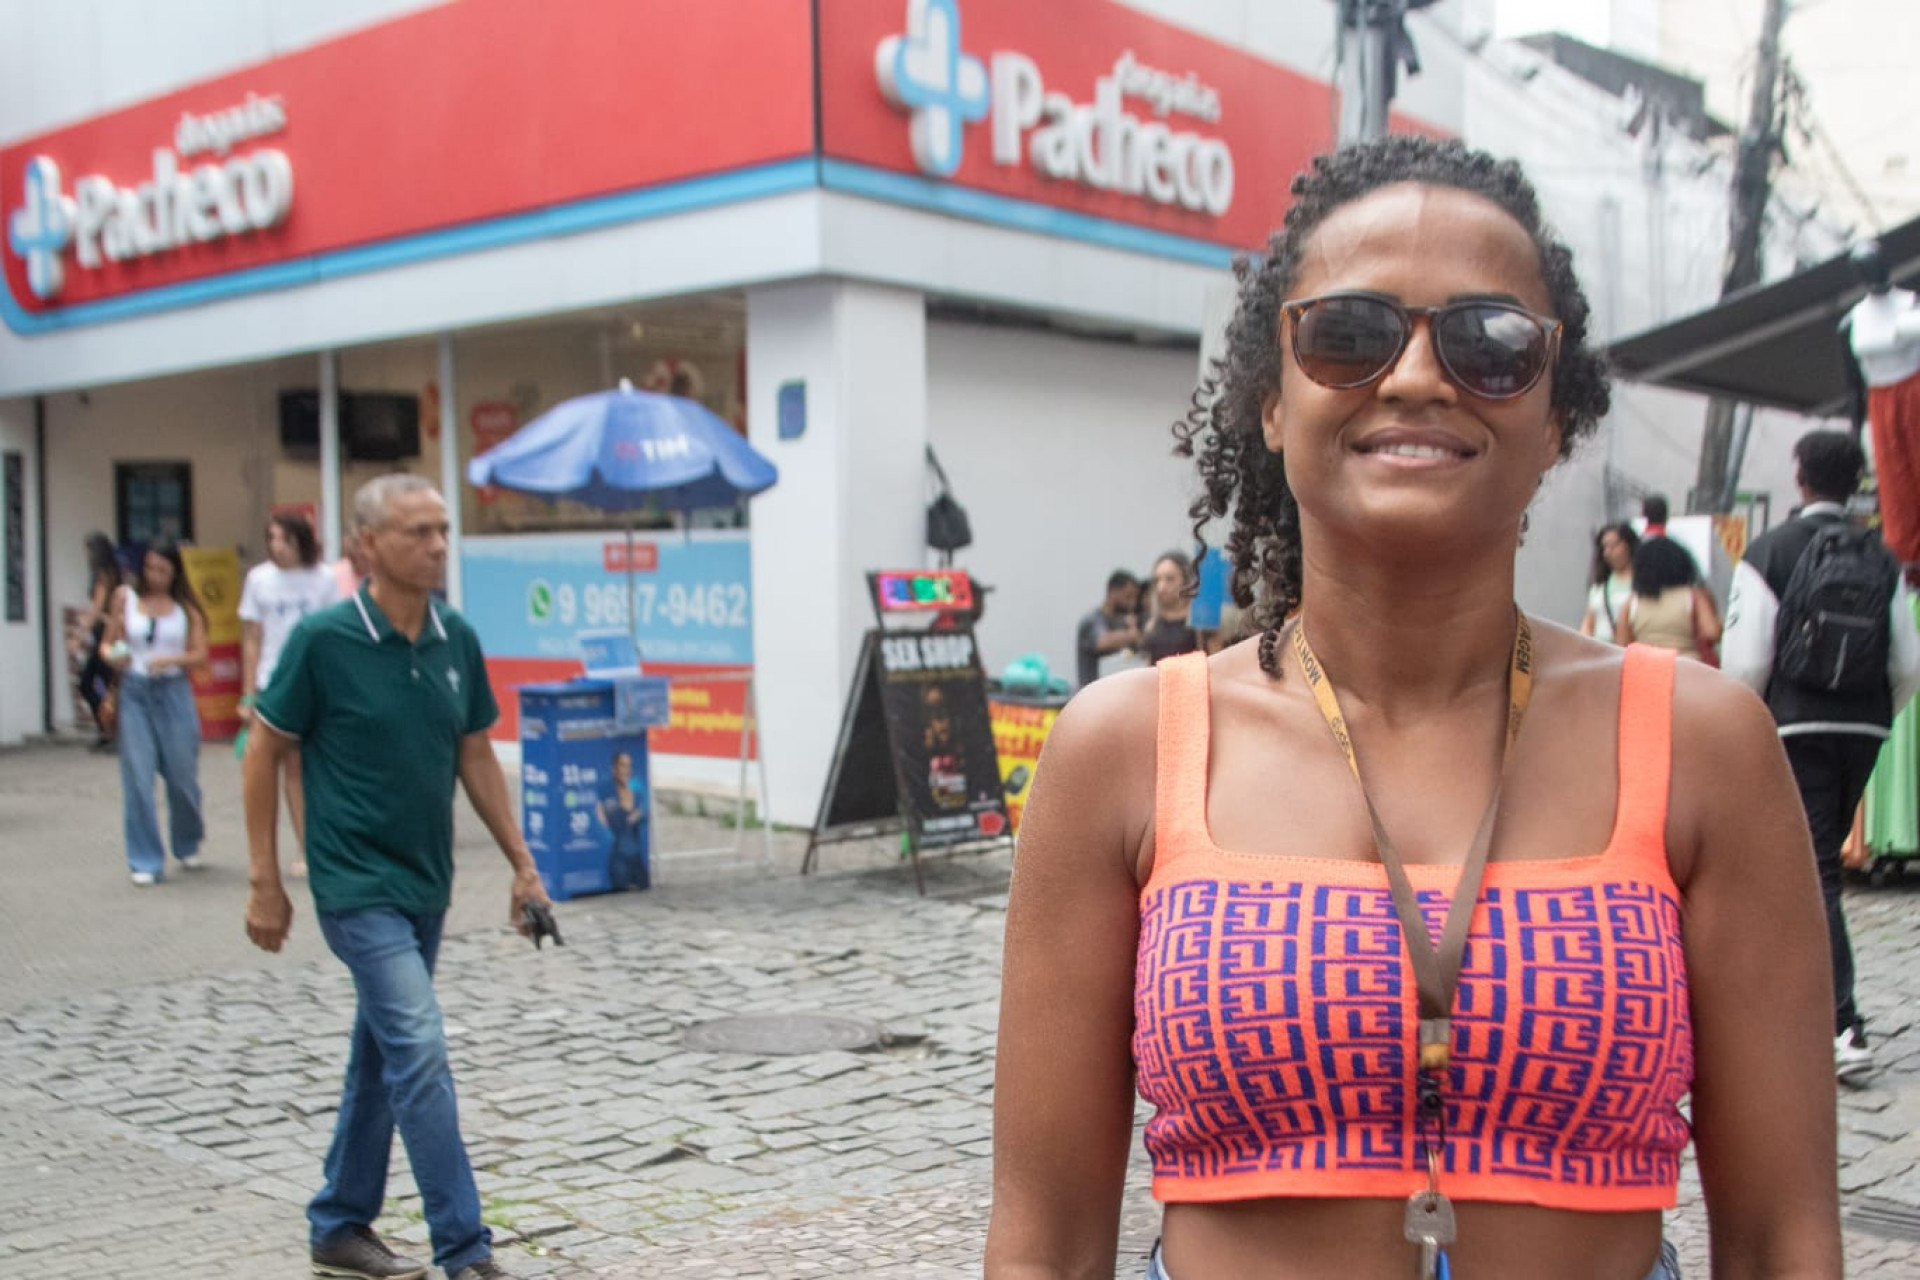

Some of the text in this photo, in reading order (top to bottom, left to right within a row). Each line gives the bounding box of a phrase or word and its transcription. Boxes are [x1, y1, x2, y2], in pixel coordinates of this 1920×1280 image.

[991, 51, 1233, 216] Pacheco
[76, 146, 293, 268] Pacheco
[557, 582, 576, 625] 9
